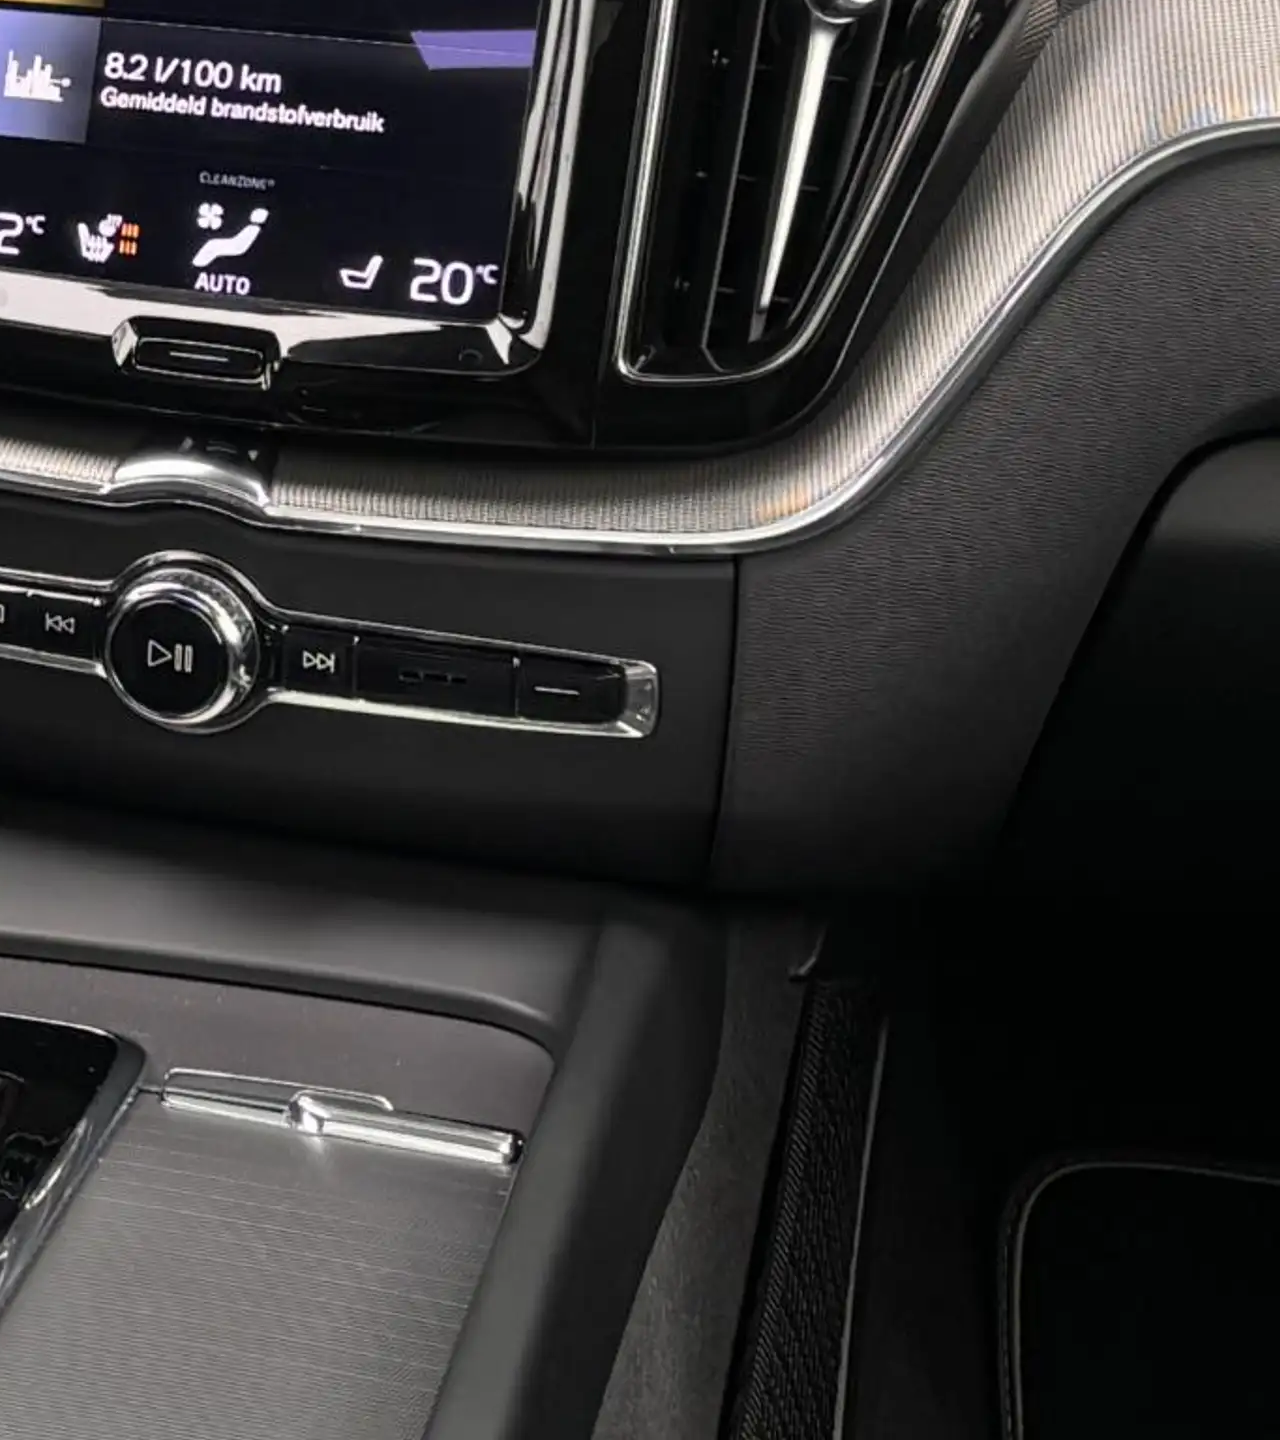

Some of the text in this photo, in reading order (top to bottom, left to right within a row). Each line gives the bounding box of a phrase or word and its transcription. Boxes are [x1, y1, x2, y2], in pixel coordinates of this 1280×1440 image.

[104, 52, 148, 81] 8.2
[239, 65, 282, 94] km
[100, 86, 385, 133] Gemiddeld brandstofverbruik
[194, 272, 250, 295] AUTO
